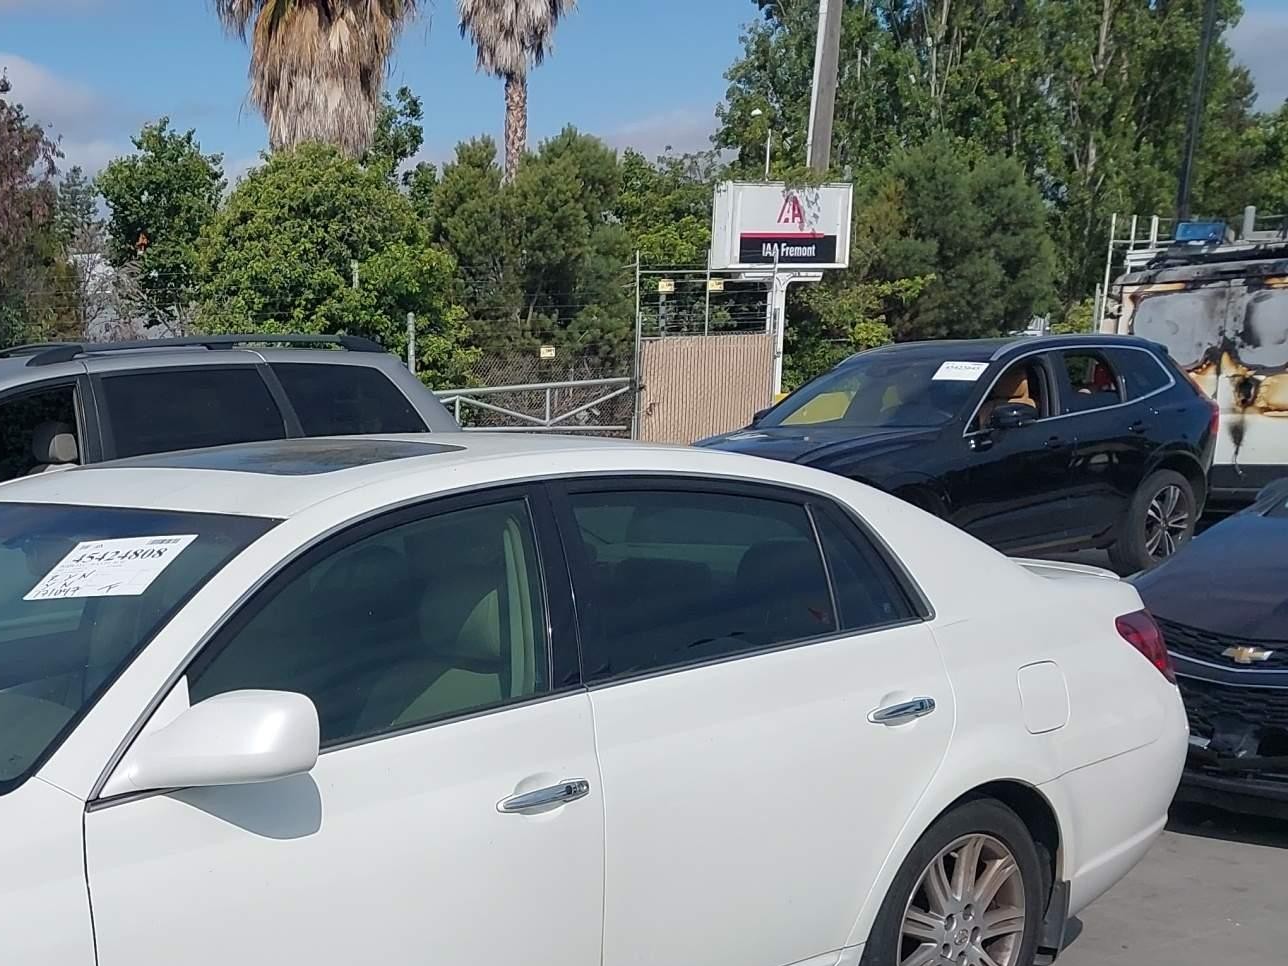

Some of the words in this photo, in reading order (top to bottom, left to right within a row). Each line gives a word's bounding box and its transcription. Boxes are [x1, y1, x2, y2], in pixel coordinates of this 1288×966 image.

[762, 242, 778, 257] IAA
[781, 242, 816, 257] Fremont
[72, 547, 168, 563] 45424808
